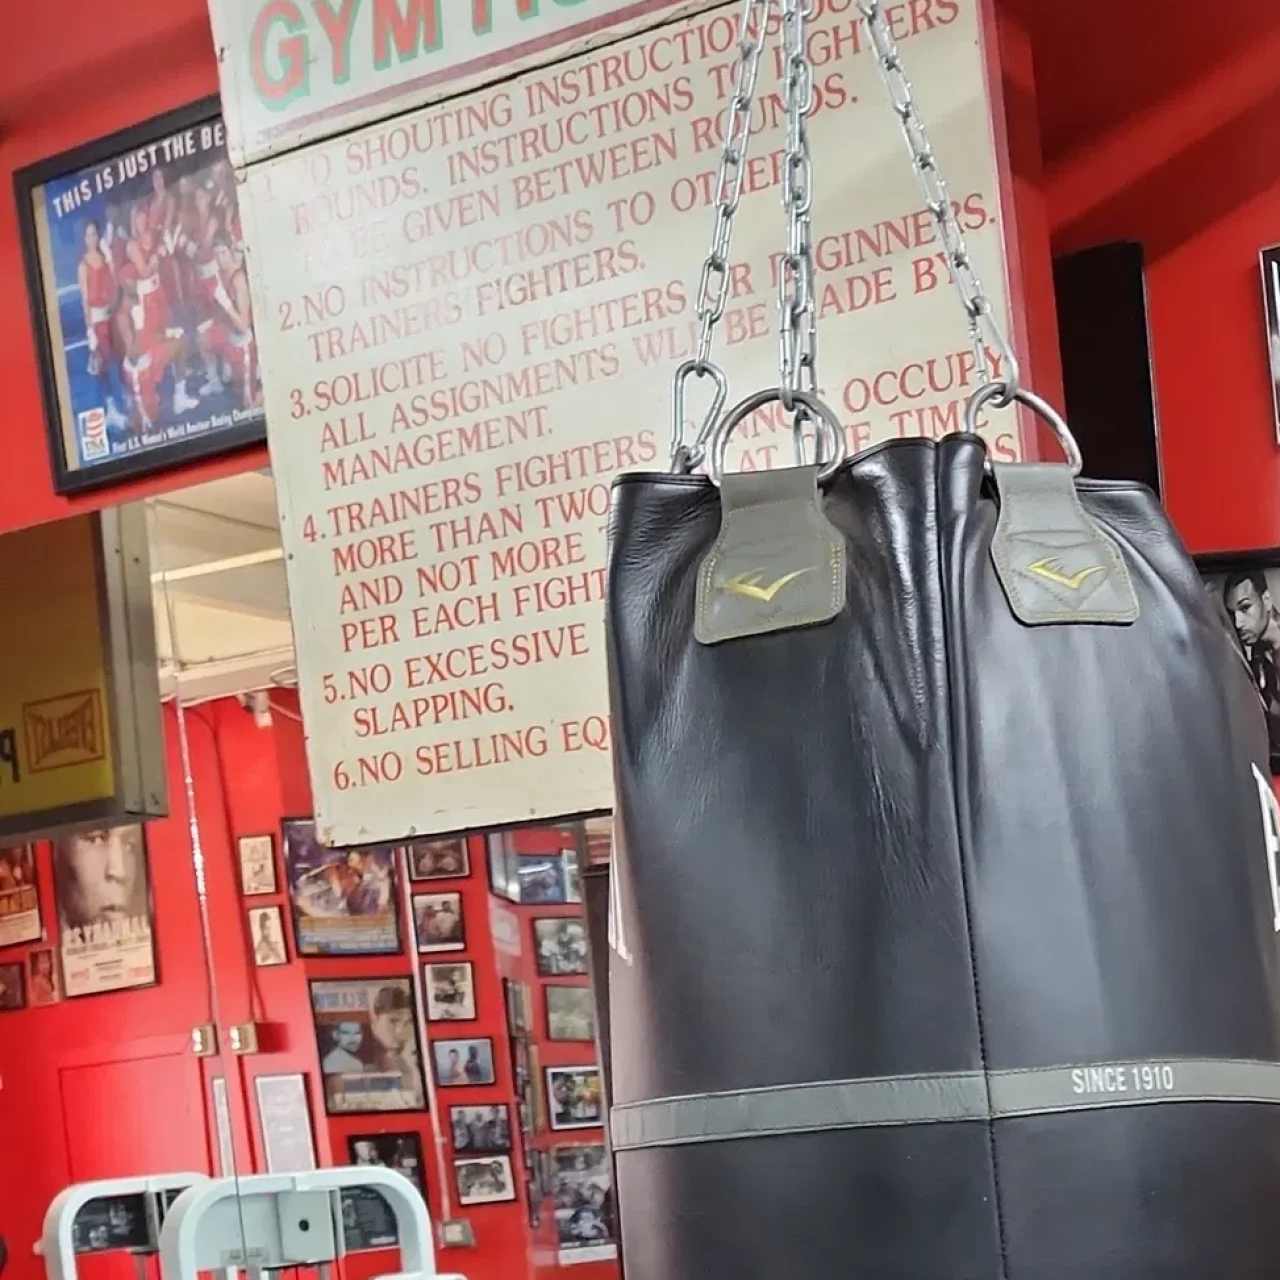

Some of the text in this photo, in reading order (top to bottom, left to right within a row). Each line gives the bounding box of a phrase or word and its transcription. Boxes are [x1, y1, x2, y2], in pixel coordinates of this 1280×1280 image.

[250, 0, 445, 113] GYM
[52, 179, 93, 218] THIS
[95, 166, 114, 194] IS
[117, 145, 157, 184] JUST
[160, 132, 197, 162] THE
[291, 167, 428, 236] RUNDS.
[444, 76, 694, 187] INSTRUCTIONS
[346, 94, 513, 175] SHOUTING
[402, 185, 500, 244] GIVEN
[511, 128, 677, 210] BETWEEN
[360, 208, 594, 308] INSTRUCTIONS
[606, 190, 656, 233] TO
[308, 239, 647, 363] TRAINERS FIGHTERS.
[460, 331, 507, 373] NO
[520, 279, 687, 356] FIGHTERS
[319, 413, 377, 453] ALL
[390, 342, 620, 433] ASSIGNMENTS
[723, 303, 772, 346] BE
[816, 266, 897, 321] ADE
[321, 405, 553, 491] MANAGEMENT.
[333, 529, 419, 576] MORE
[430, 504, 523, 553] THAN
[739, 445, 778, 472] AT
[889, 397, 988, 440] TIM
[495, 429, 658, 493] FIGHTERS
[339, 575, 403, 615] AND
[416, 555, 481, 598] NOT
[491, 532, 587, 582] MORE
[341, 614, 400, 653] PER
[412, 592, 501, 638] EACH
[404, 623, 590, 689] EXCESSIVE
[353, 682, 515, 738] SLAPPING.
[416, 725, 548, 776] SELLING
[560, 714, 610, 753] EQ
[1071, 1066, 1173, 1093] SINCE 1910
